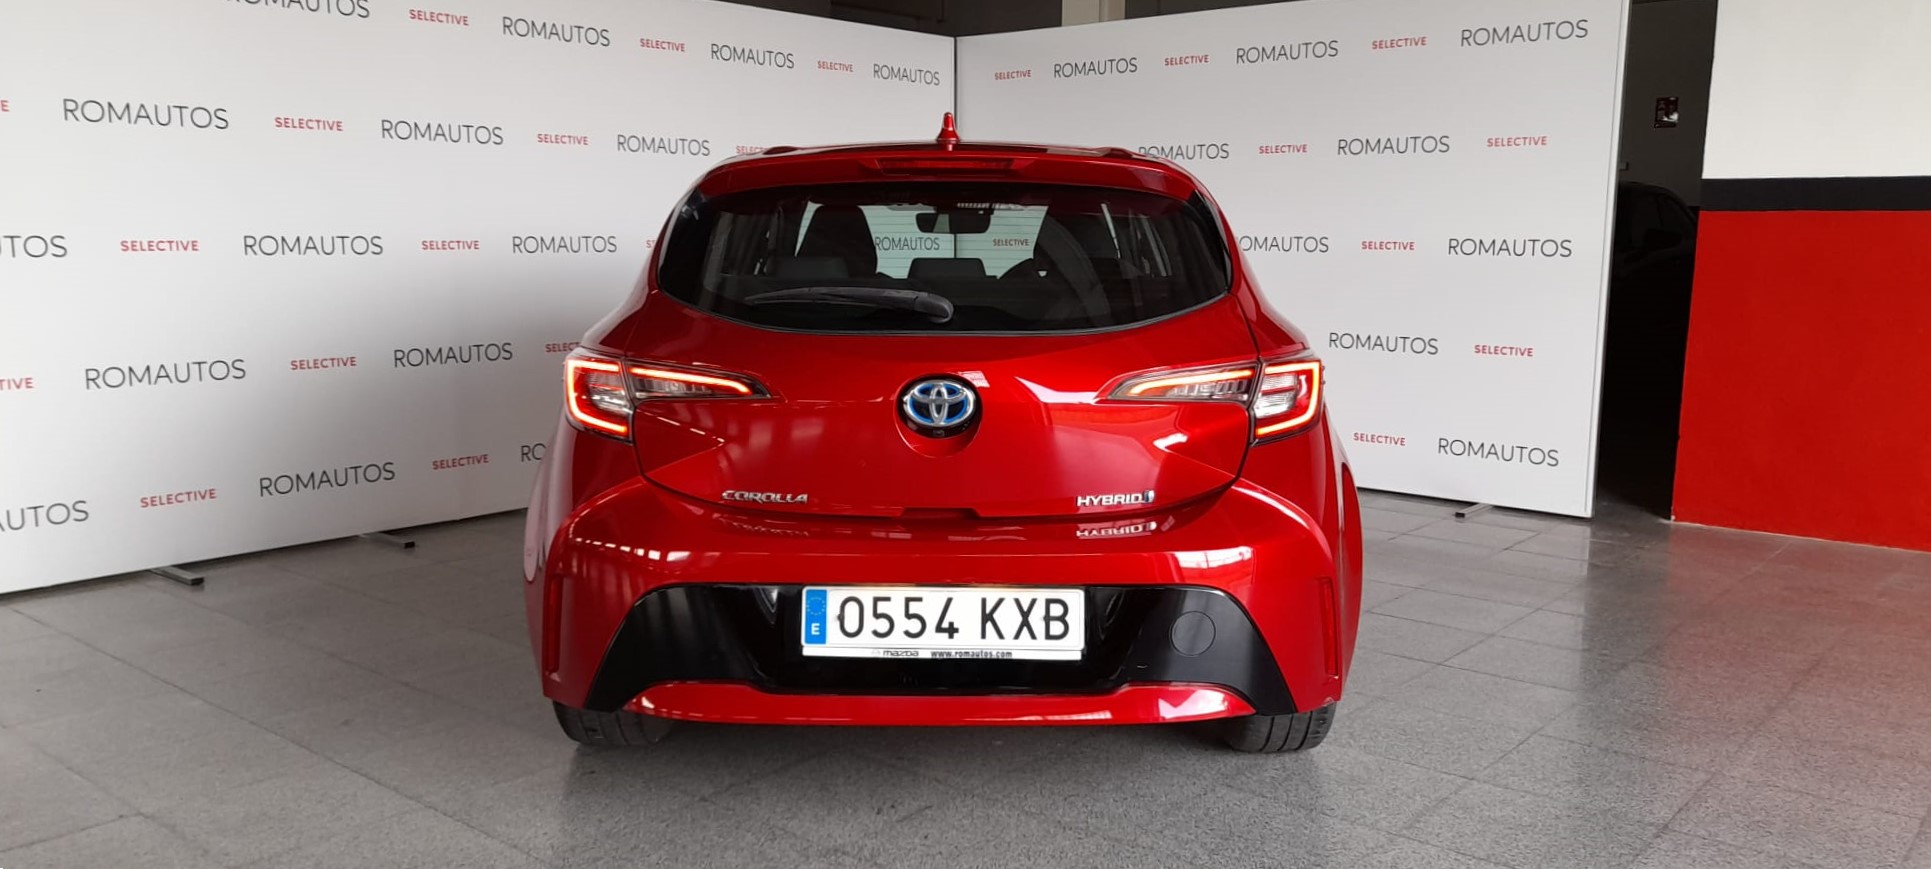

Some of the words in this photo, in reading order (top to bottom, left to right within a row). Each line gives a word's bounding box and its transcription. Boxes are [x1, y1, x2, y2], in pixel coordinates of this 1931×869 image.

[408, 8, 470, 27] SELECTIVE
[502, 15, 611, 48] ROMAUTOS
[639, 37, 686, 53] SELECTIVE
[710, 43, 795, 70] ROMAUTOS
[817, 59, 854, 73] SELECTIVE
[873, 63, 941, 87] ROMAUTOS
[994, 68, 1032, 81] SELECTIVE
[1053, 56, 1138, 79] ROMAUTOS
[1164, 54, 1209, 67] SELECTIVE
[1236, 39, 1339, 65] ROMAUTOS
[1371, 36, 1427, 50] SELECTIVE
[1460, 18, 1589, 47] ROMAUTOS
[62, 98, 229, 130] ROMAUTOS
[274, 116, 344, 132] SELECTIVE
[381, 119, 504, 146] ROMAUTOS
[536, 133, 589, 146] SELECTIVE
[617, 133, 711, 157] ROMAUTOS
[1258, 143, 1308, 155] SELECTIVE
[1337, 135, 1450, 158] ROMAUTOS
[1486, 135, 1548, 148] SELECTIVE
[120, 238, 200, 252] SELECTIVE
[243, 234, 384, 258] ROMAUTOS
[421, 239, 480, 252] SELECTIVE
[511, 235, 618, 254] ROMAUTOS
[875, 236, 940, 251] ROMAUTOS
[992, 238, 1030, 248] SELECTIVE
[1361, 240, 1415, 251] SELECTIVE
[1448, 237, 1573, 258] ROMAUTOS
[1328, 332, 1439, 356] ROMAUTOS
[1474, 344, 1534, 358] SELECTIVE
[85, 358, 247, 390] ROMAUTOS
[290, 356, 358, 371] SELECTIVE
[393, 341, 514, 368] ROMAUTOS
[1353, 431, 1406, 447] SELECTIVE
[1437, 437, 1559, 468] ROMAUTOS
[140, 487, 218, 509] SELECTIVE
[259, 461, 396, 497] ROMAUTOS
[432, 453, 490, 471] SELECTIVE
[722, 490, 809, 504] COROLLA
[1076, 493, 1143, 507] HYBRID
[810, 623, 821, 636] E
[838, 596, 960, 640] 0554
[980, 597, 1071, 641] KXB
[930, 649, 1013, 659] www.romautos.com
